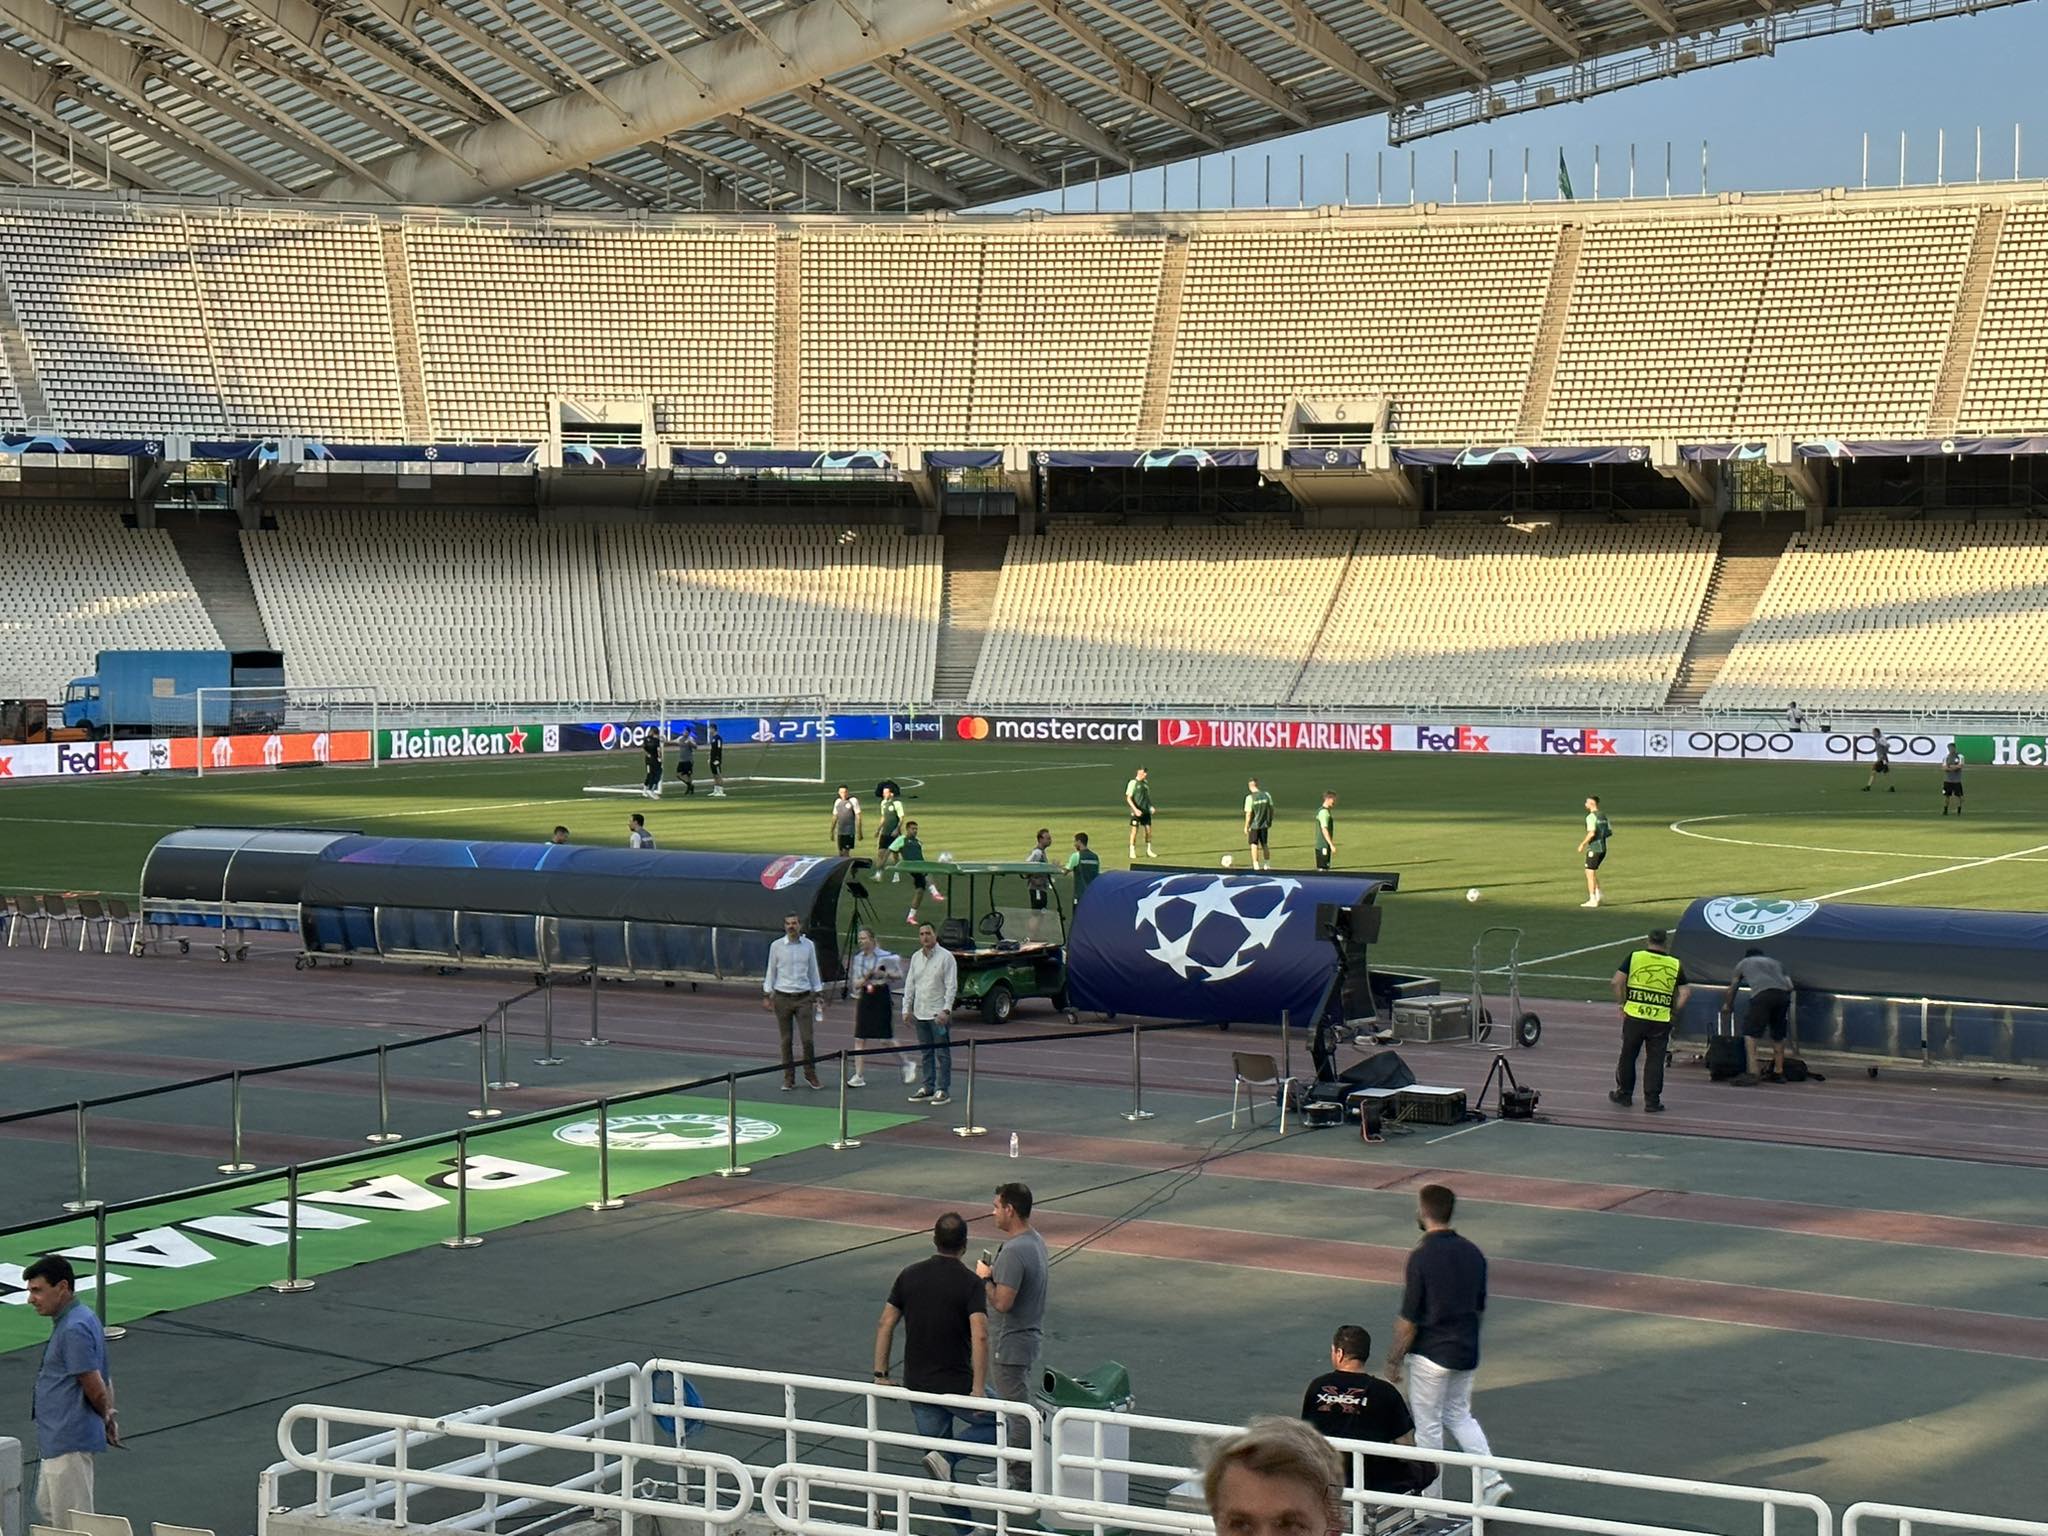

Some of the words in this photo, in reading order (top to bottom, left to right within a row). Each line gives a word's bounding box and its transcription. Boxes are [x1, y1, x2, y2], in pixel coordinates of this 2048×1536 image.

[596, 404, 608, 421] 4
[1335, 404, 1346, 421] 6
[620, 721, 671, 748] pei
[779, 721, 836, 738] PS5
[904, 722, 939, 731] RESPECT
[996, 718, 1143, 741] mastercard
[1208, 721, 1290, 748] TURKISH
[1296, 723, 1383, 750] AIRLINES
[1416, 724, 1490, 752] FedEx
[390, 728, 504, 759] Heineken
[1541, 728, 1617, 754] FedEx
[1688, 732, 1794, 757] oppo
[57, 741, 129, 773] FedEx
[1732, 924, 1765, 935] 1908
[1628, 989, 1672, 1006] STEWARD
